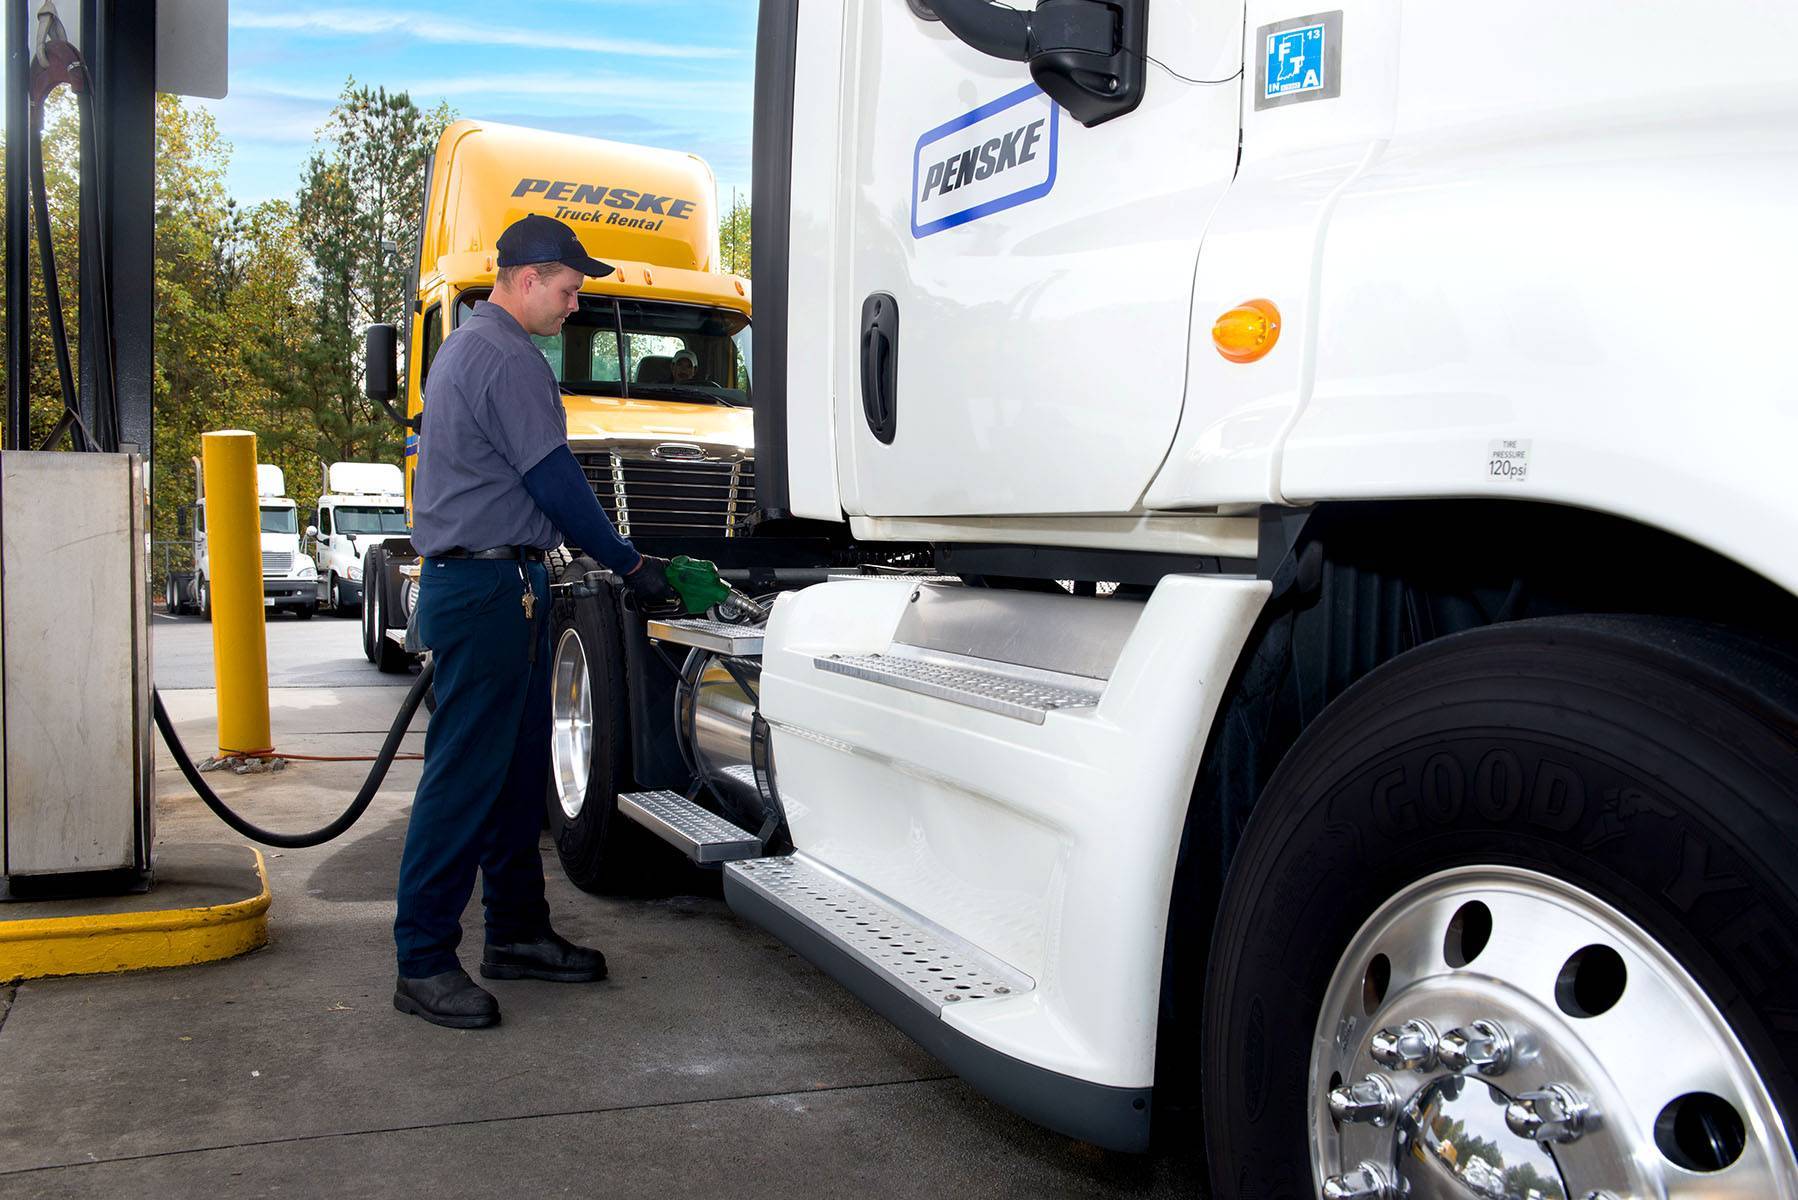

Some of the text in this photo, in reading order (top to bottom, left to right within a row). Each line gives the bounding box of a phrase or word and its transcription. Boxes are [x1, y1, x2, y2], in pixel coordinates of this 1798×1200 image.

[1307, 30, 1320, 39] 13
[1269, 82, 1280, 92] IN
[921, 118, 1045, 202] PENSKE
[511, 178, 696, 219] PENSKE
[554, 206, 663, 231] Truck Rental
[1489, 460, 1527, 479] 120psi
